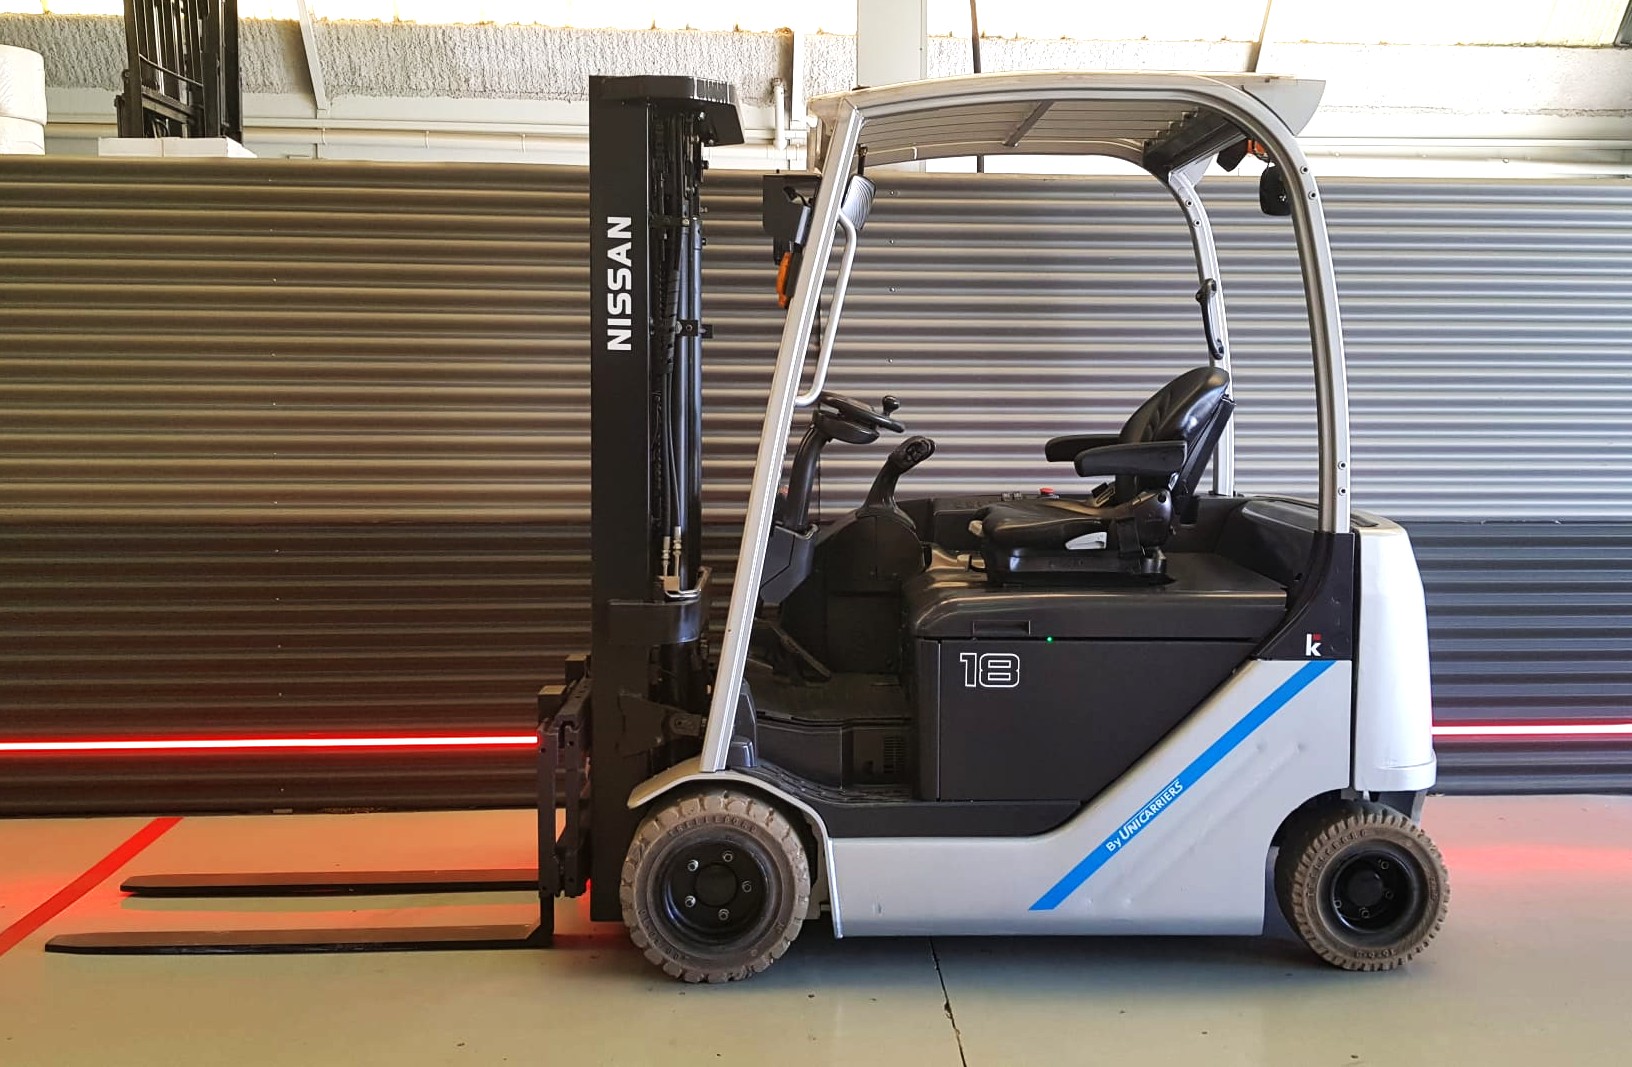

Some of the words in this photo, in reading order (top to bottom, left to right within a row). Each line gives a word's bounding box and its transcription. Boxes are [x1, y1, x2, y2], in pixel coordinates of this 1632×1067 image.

[607, 216, 632, 351] NISSAN
[959, 652, 1020, 688] 18
[1105, 837, 1122, 852] By
[1119, 778, 1183, 840] UNICARRIERS
